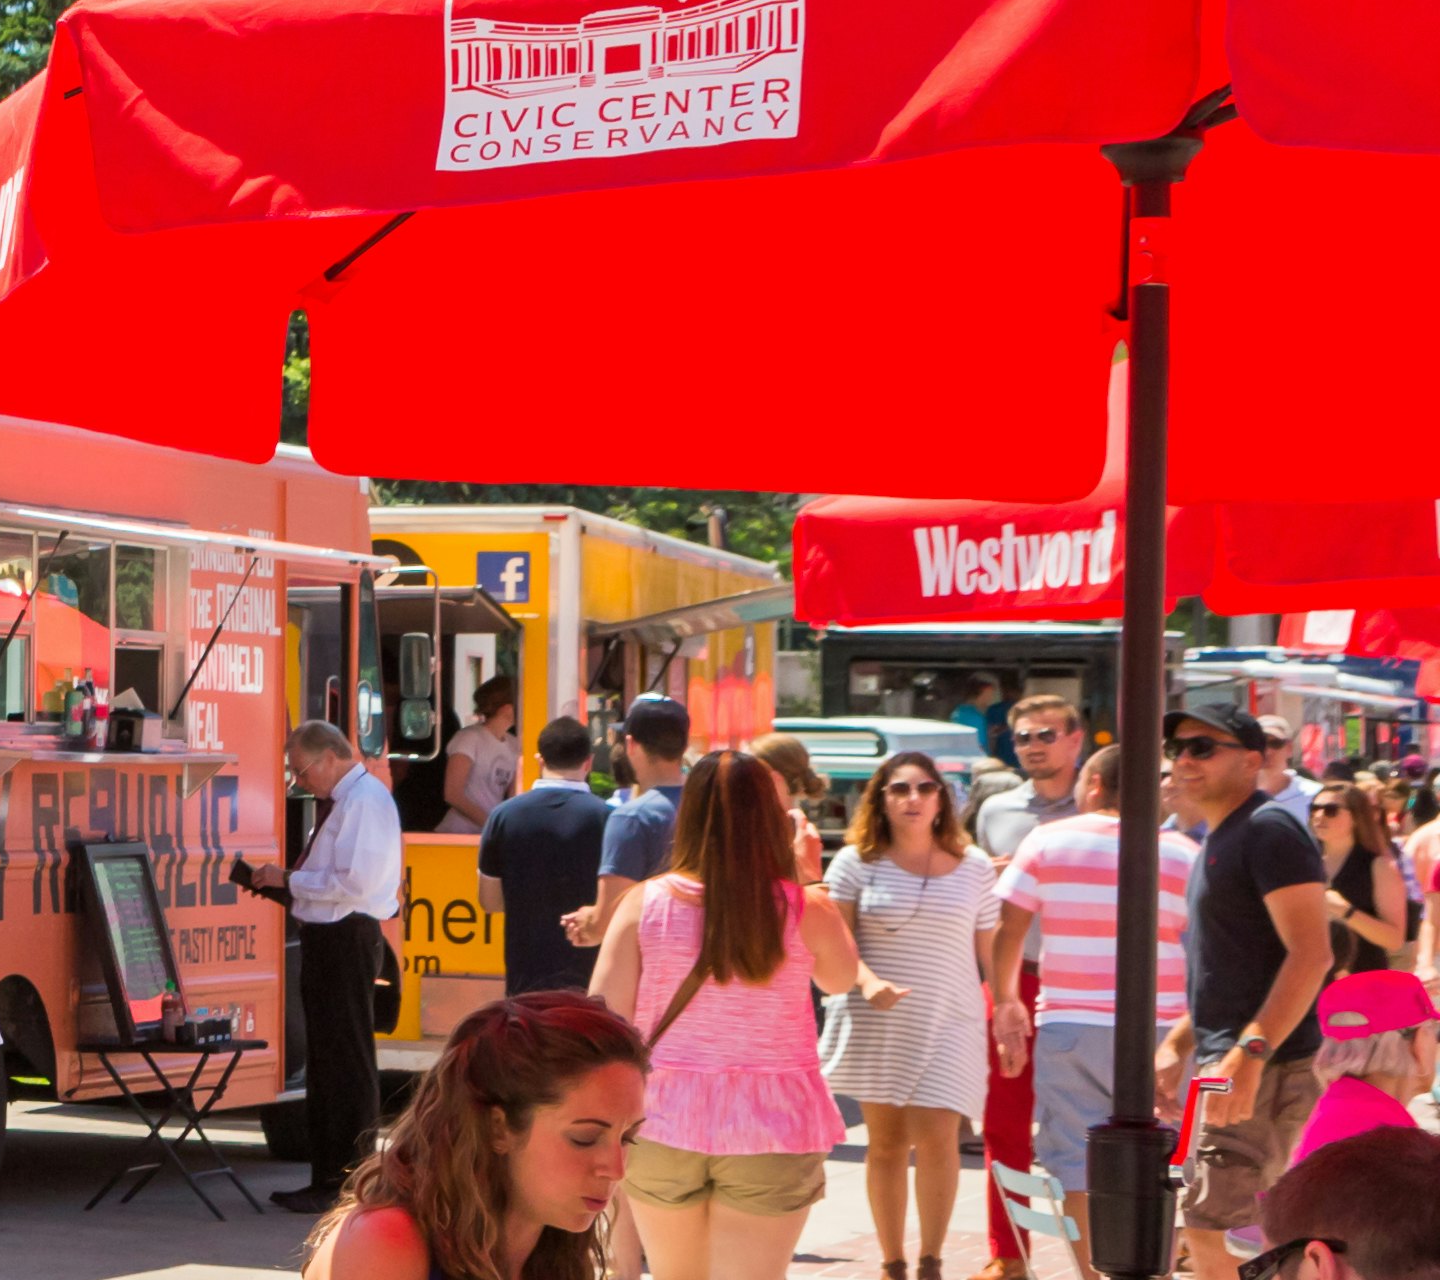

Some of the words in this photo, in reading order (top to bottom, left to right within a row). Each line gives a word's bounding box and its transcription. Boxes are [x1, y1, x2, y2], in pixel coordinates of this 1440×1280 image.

[454, 102, 576, 139] CIVIC
[598, 77, 791, 122] CENTER
[450, 109, 789, 163] CONSERVANCY
[913, 509, 1117, 597] Westword
[190, 588, 212, 629] THE
[216, 583, 281, 636] ORIGINAL
[189, 641, 264, 694] HANDHELD
[188, 700, 223, 750] MEAL
[179, 927, 214, 964] PASTY
[218, 925, 256, 961] PEOPLE
